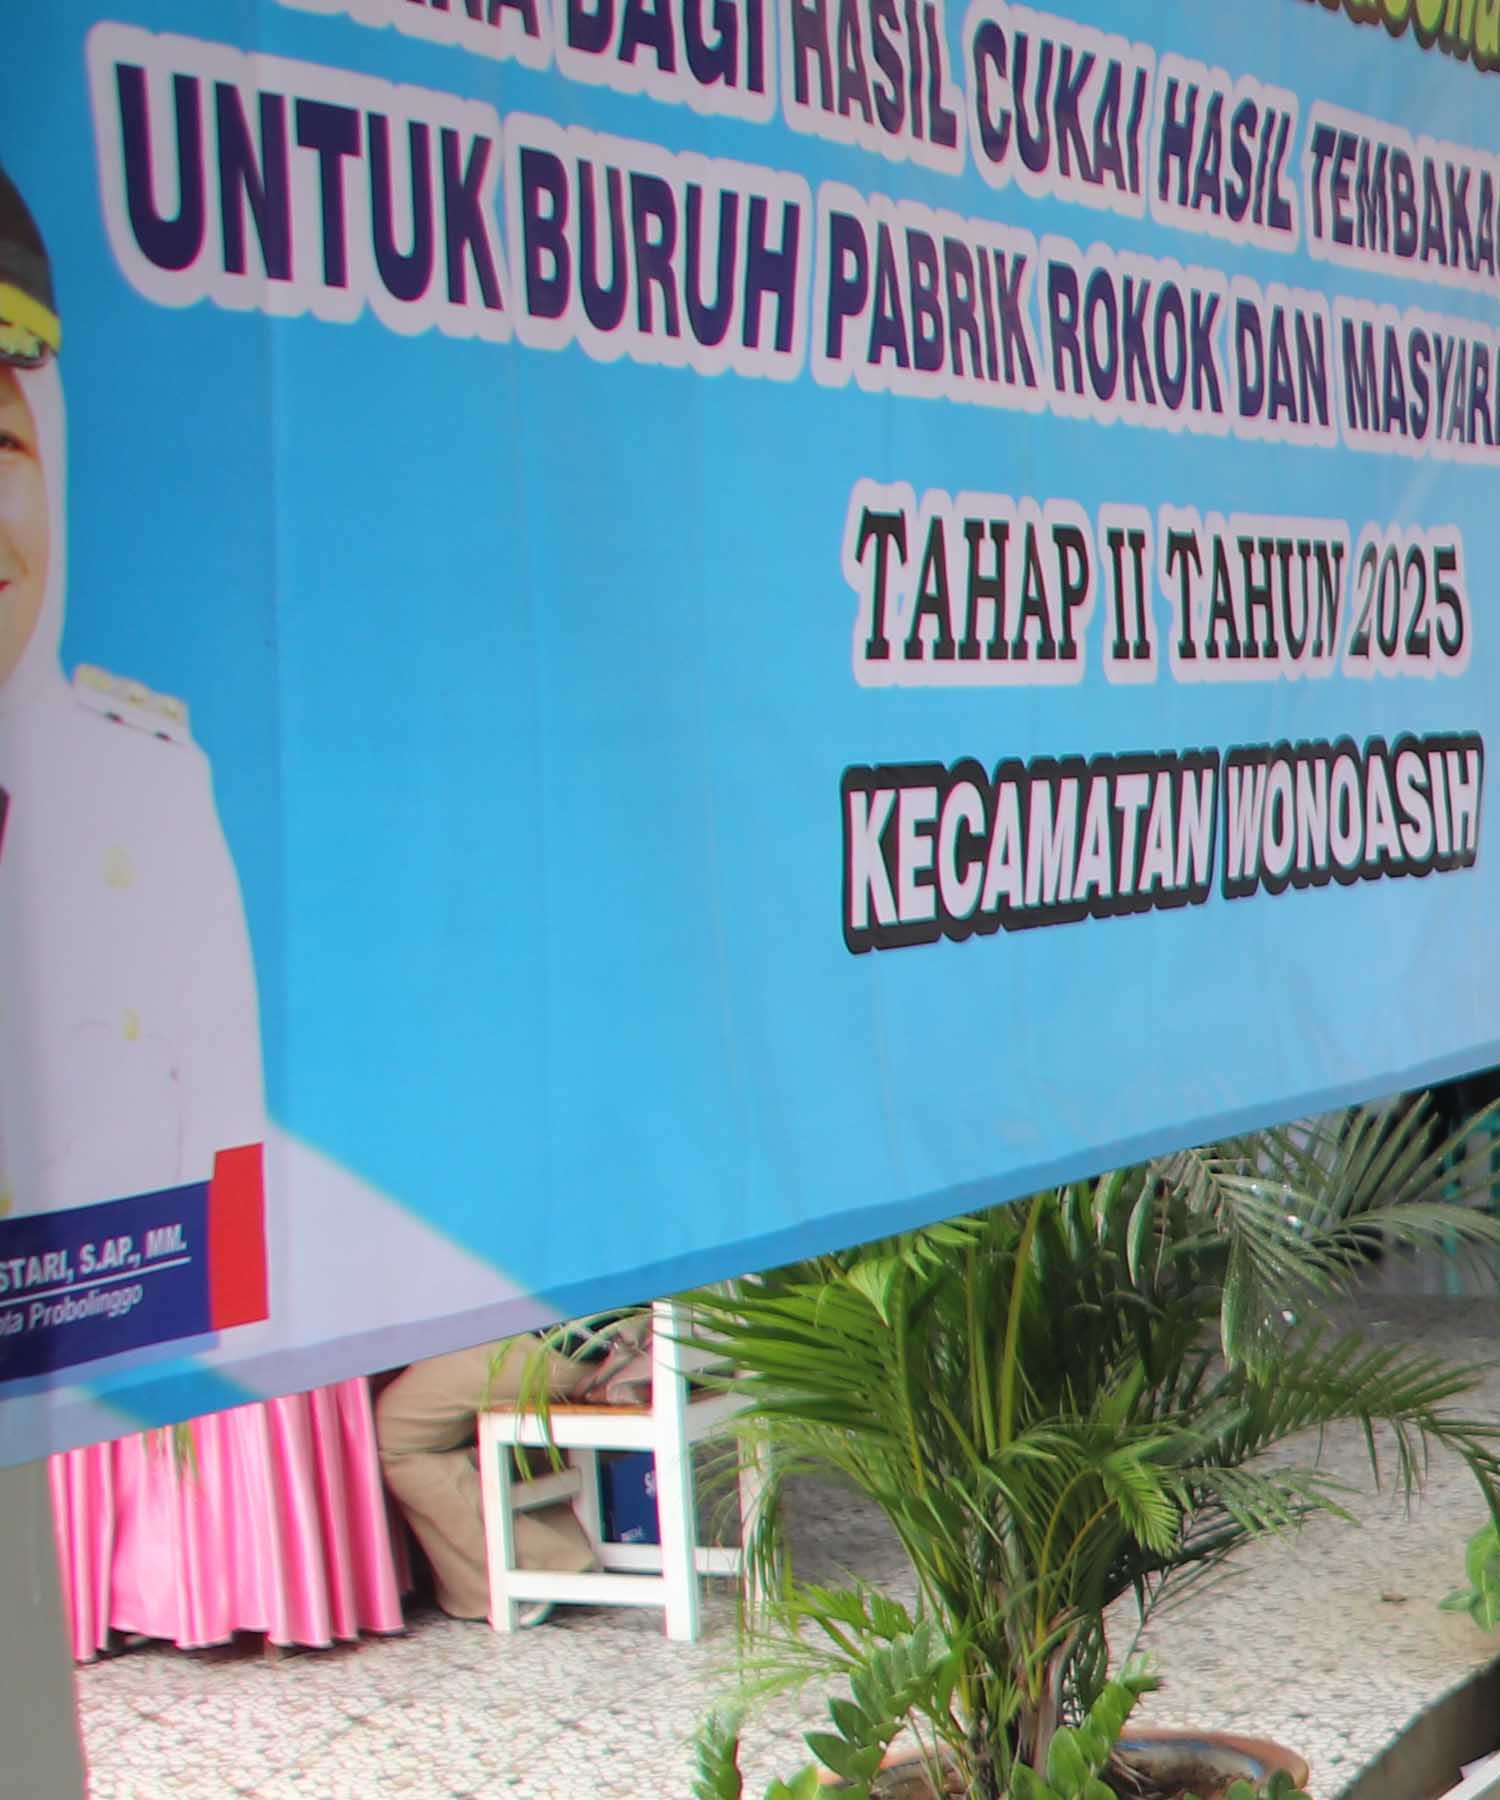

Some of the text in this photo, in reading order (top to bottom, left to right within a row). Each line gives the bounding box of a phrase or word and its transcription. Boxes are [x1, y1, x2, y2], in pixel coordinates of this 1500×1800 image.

[794, 0, 957, 148] HASIL
[974, 20, 1149, 196] CUKAI
[1156, 74, 1293, 232] HASIL
[115, 62, 504, 312] UNTUK
[518, 145, 803, 354] BURUH
[824, 210, 1037, 389] PABRIK
[1047, 262, 1222, 415] ROKOK
[1234, 297, 1330, 428] DAN
[854, 505, 1465, 662] TAHAP II TAHUN 2025
[846, 746, 1482, 931] KECAMATAN WONOASIH
[28, 1282, 144, 1331] Probolinggo
